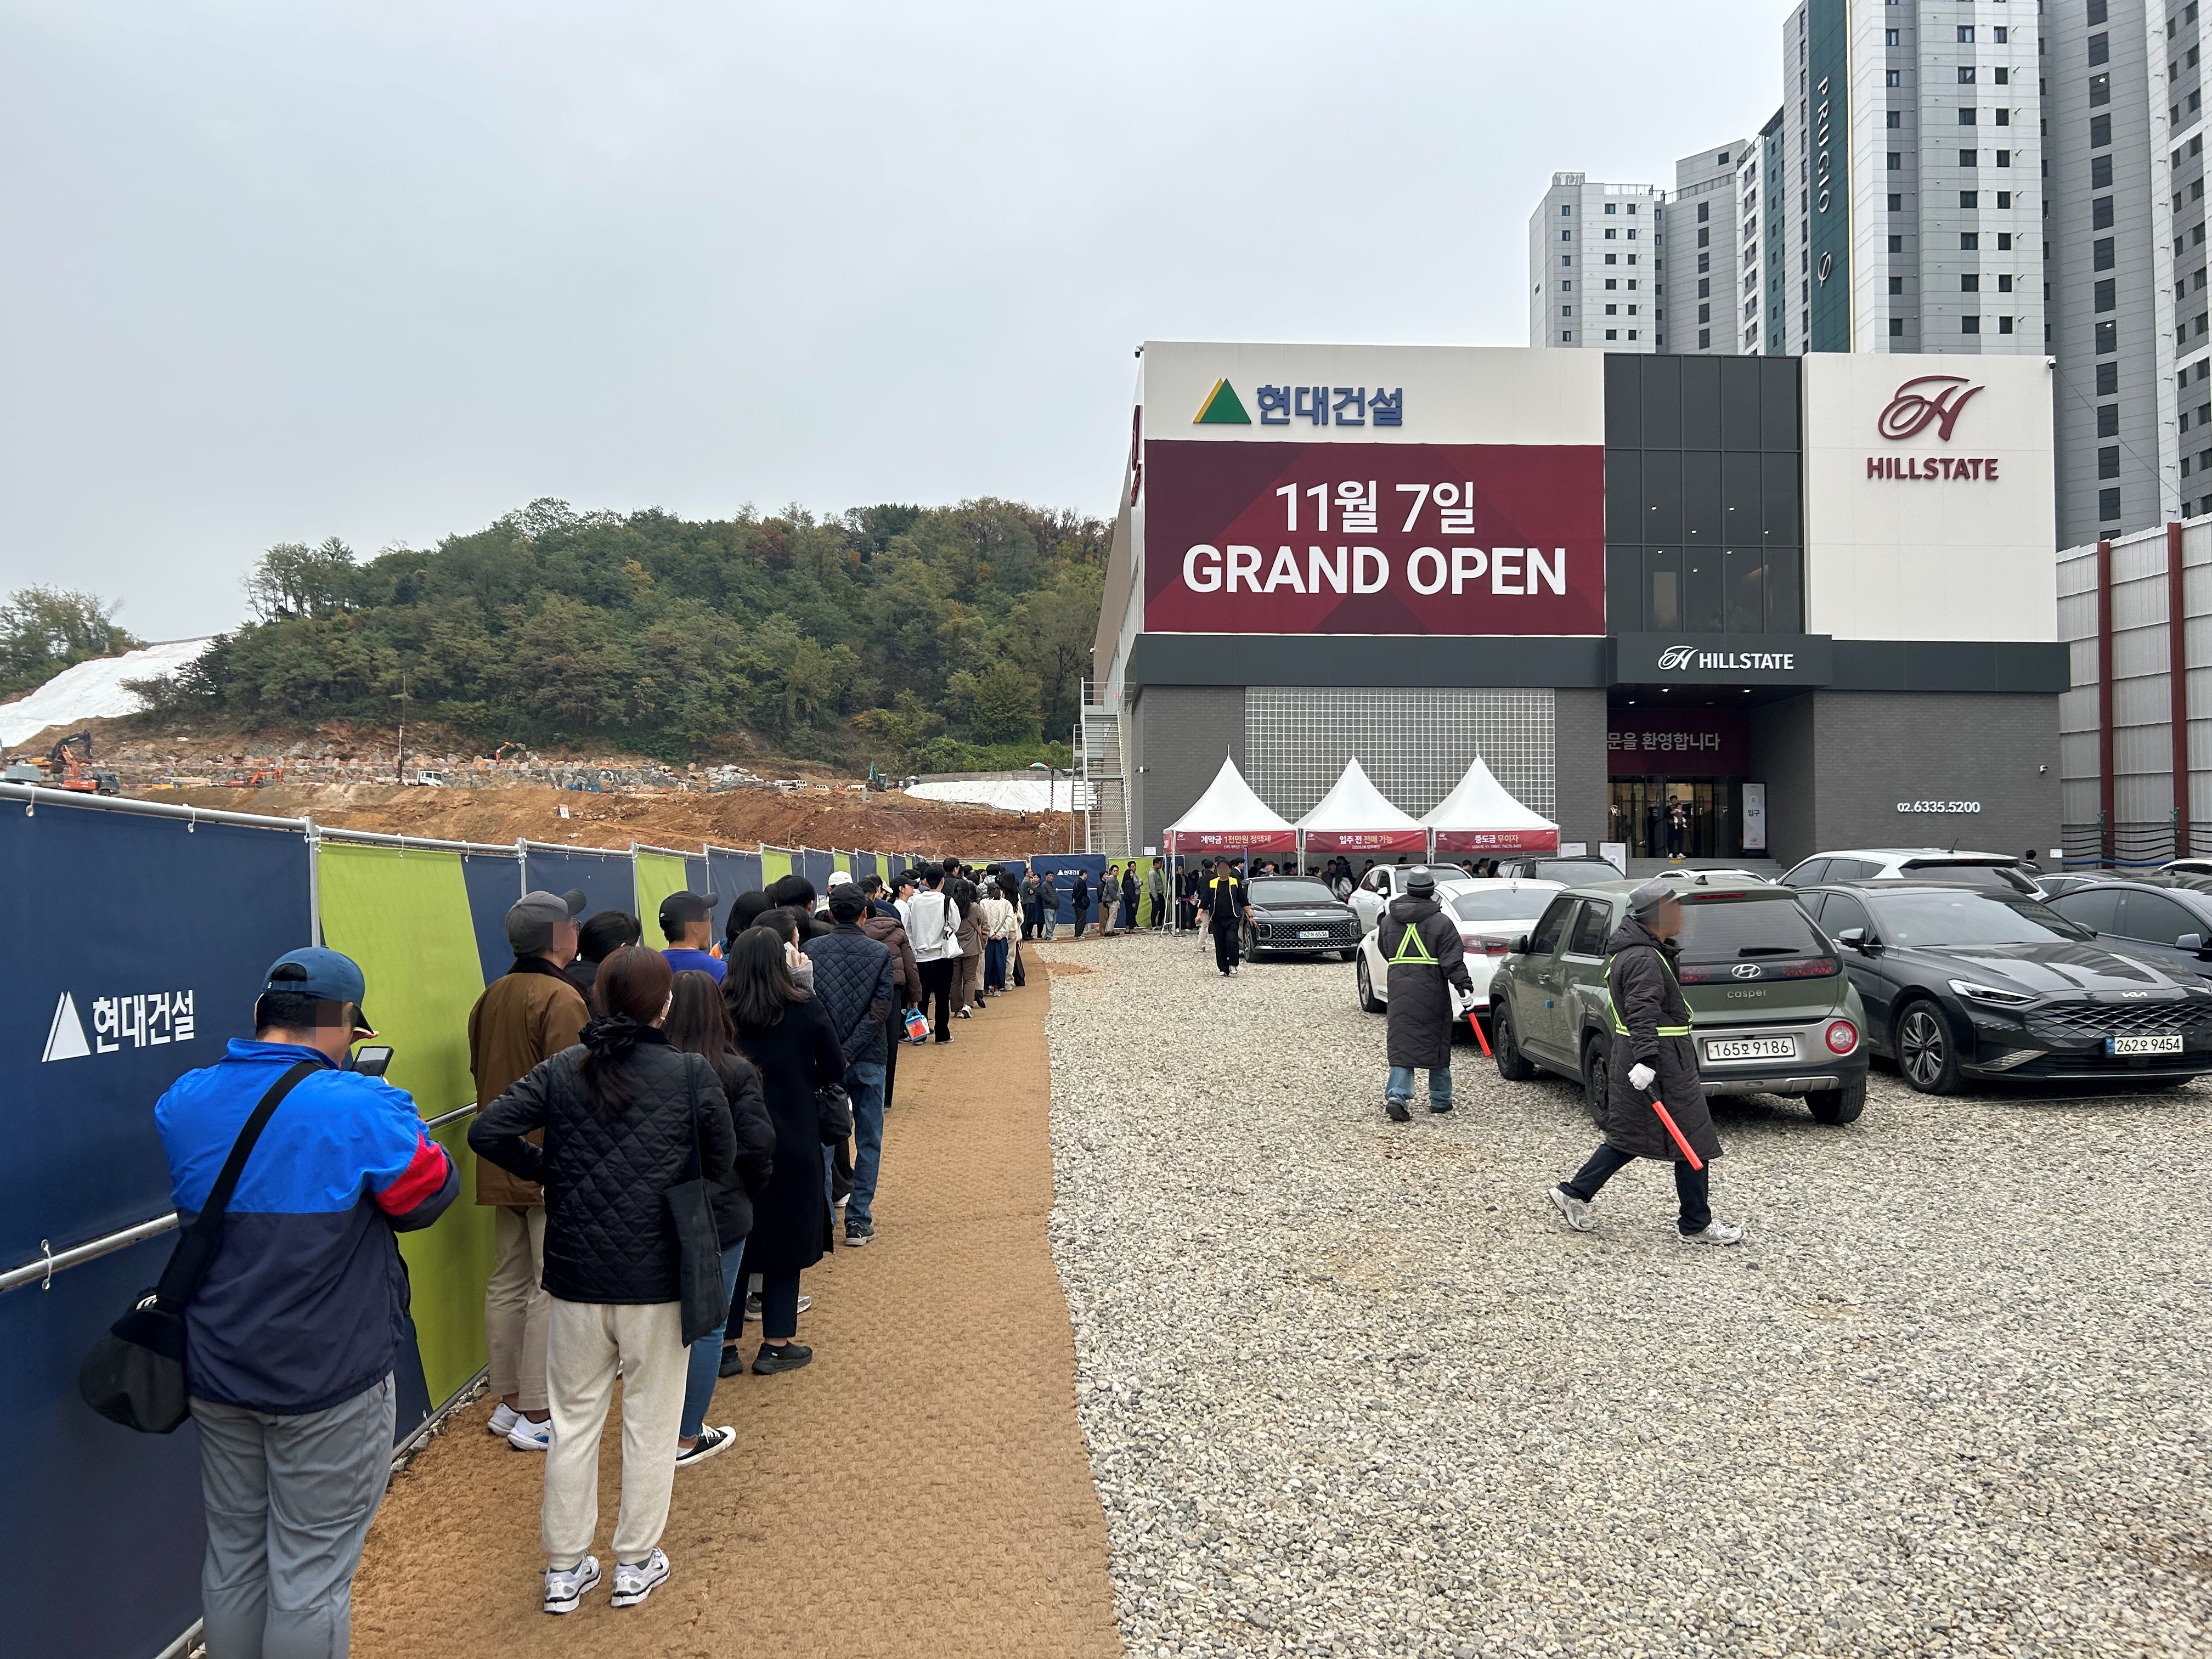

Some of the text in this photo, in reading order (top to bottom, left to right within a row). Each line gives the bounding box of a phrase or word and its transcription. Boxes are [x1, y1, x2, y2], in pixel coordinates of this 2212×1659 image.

[1817, 75, 1830, 214] PRUGIO
[1256, 384, 1403, 426] 현대건설
[1867, 457, 1999, 481] HILLSTATE
[1275, 480, 1476, 534] 11월 7일
[1183, 544, 1566, 596] GRAND OPEN
[1699, 652, 1794, 669] HILLSTATE
[1642, 732, 1721, 751] 환영합니다
[1747, 809, 1760, 817] 입구
[1897, 800, 1980, 813] 02.6335.5200
[1200, 834, 1271, 844] 계약금 1천만원 정액제
[1339, 834, 1393, 844] 입주 전 전매 가능
[1474, 834, 1519, 844] 중도금 무이자
[1726, 989, 1768, 998] casper
[92, 989, 195, 1054] 현대건설
[1713, 1040, 1789, 1057] 165호 9186
[2116, 1038, 2180, 1052] 262오 9454
